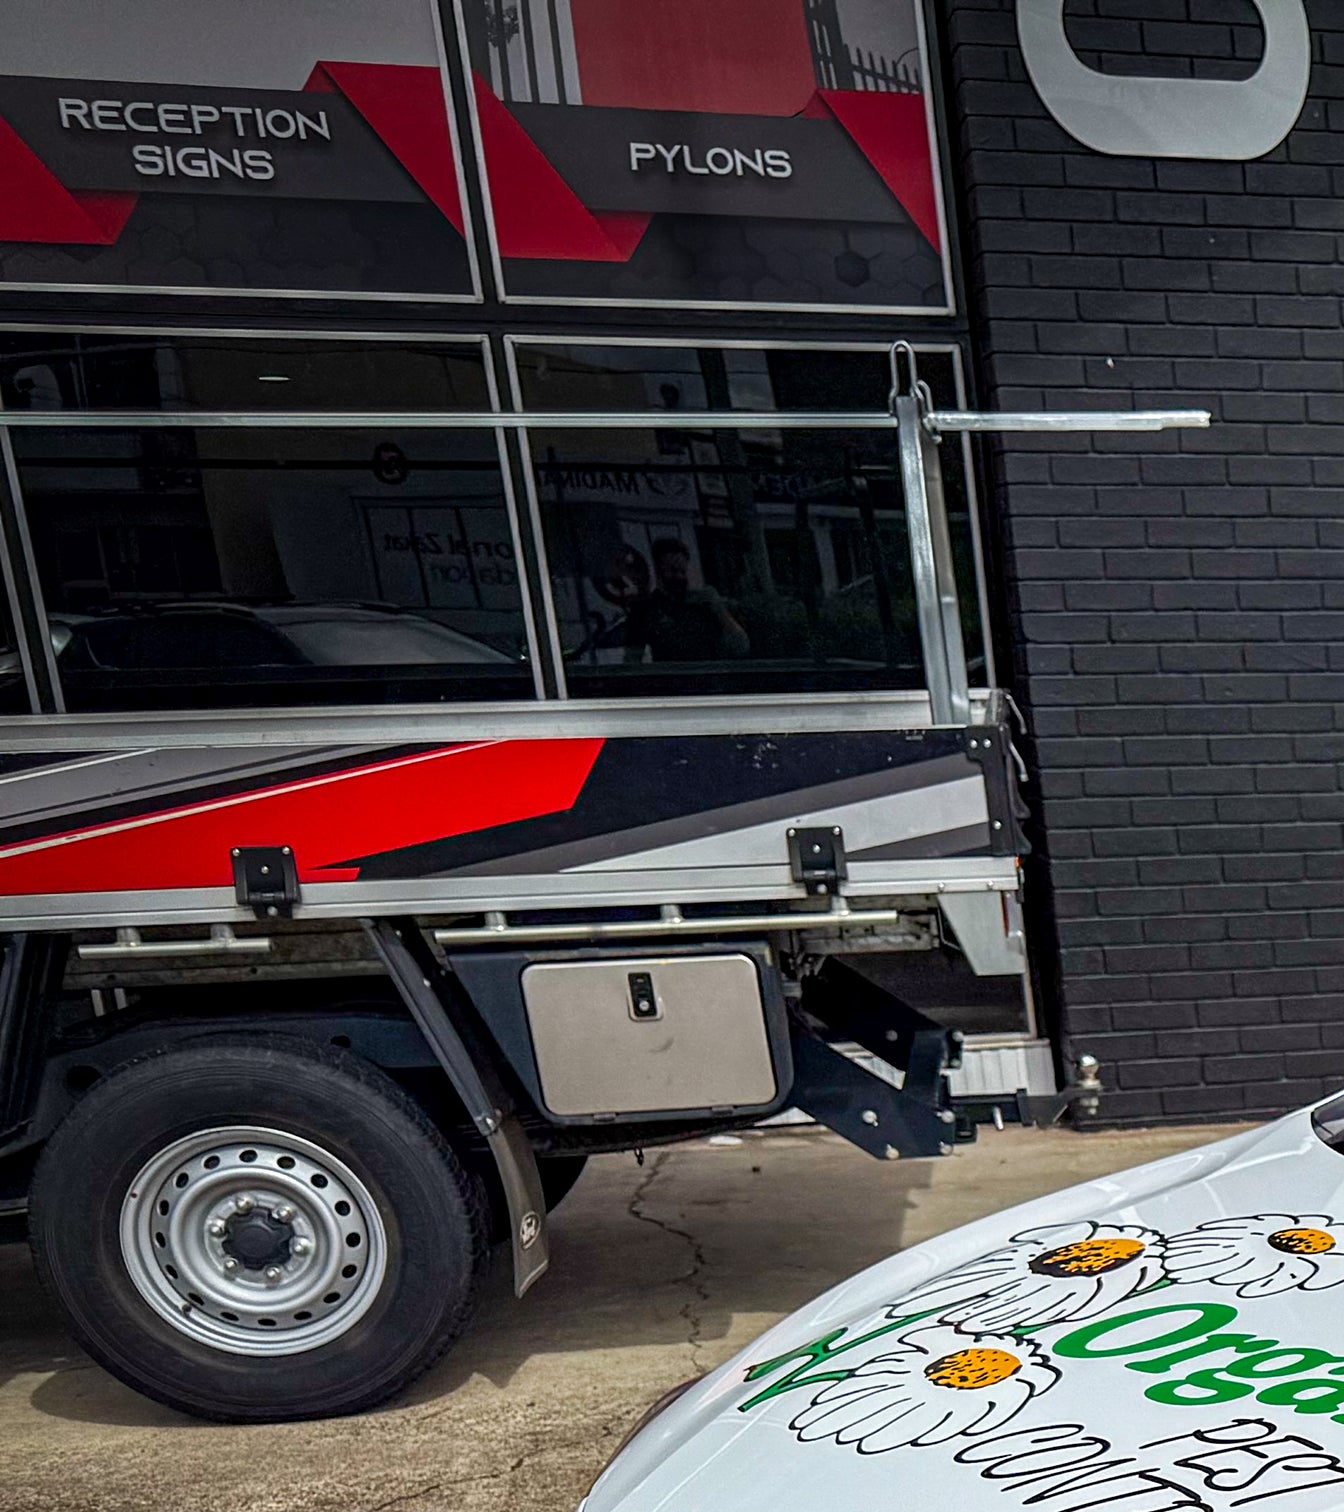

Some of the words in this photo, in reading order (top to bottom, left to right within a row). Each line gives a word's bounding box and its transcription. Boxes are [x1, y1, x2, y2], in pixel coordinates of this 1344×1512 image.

[59, 97, 331, 142] RECEPTION
[133, 145, 275, 181] SIGNS
[629, 142, 793, 179] PYLONS
